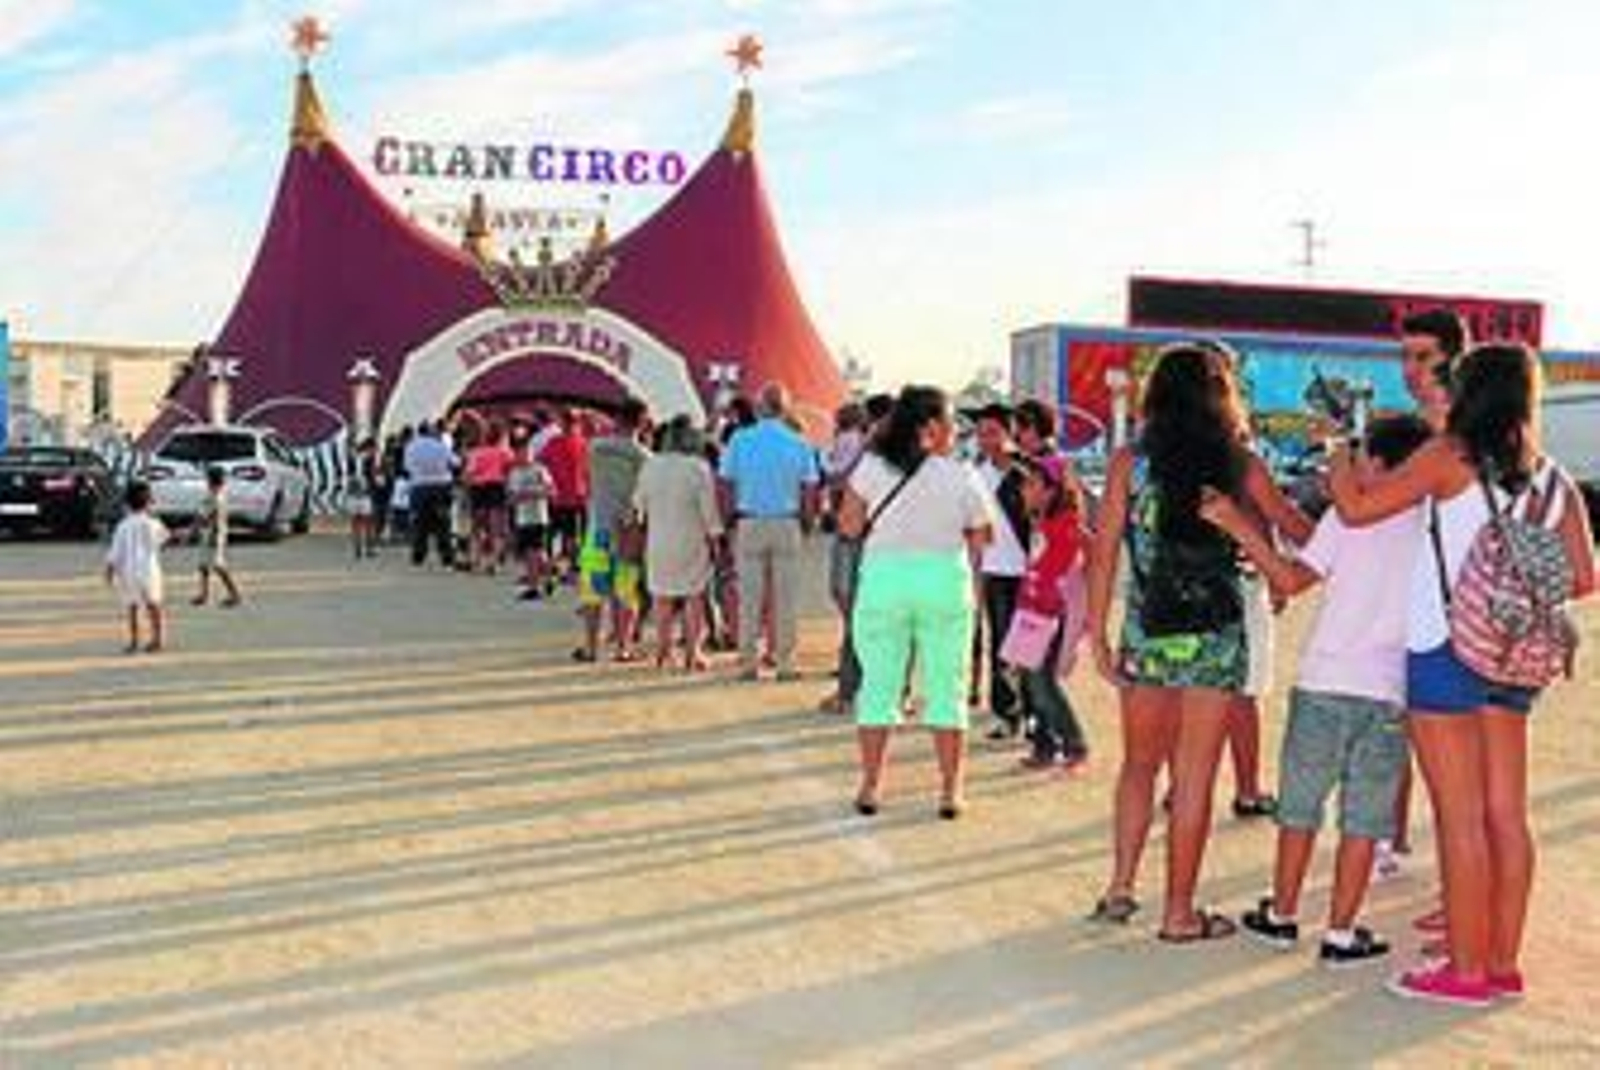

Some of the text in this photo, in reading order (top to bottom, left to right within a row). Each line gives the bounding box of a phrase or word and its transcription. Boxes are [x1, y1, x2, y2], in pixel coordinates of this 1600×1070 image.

[374, 136, 687, 185] GRAN CIRCO
[456, 321, 633, 374] ENTRADA
